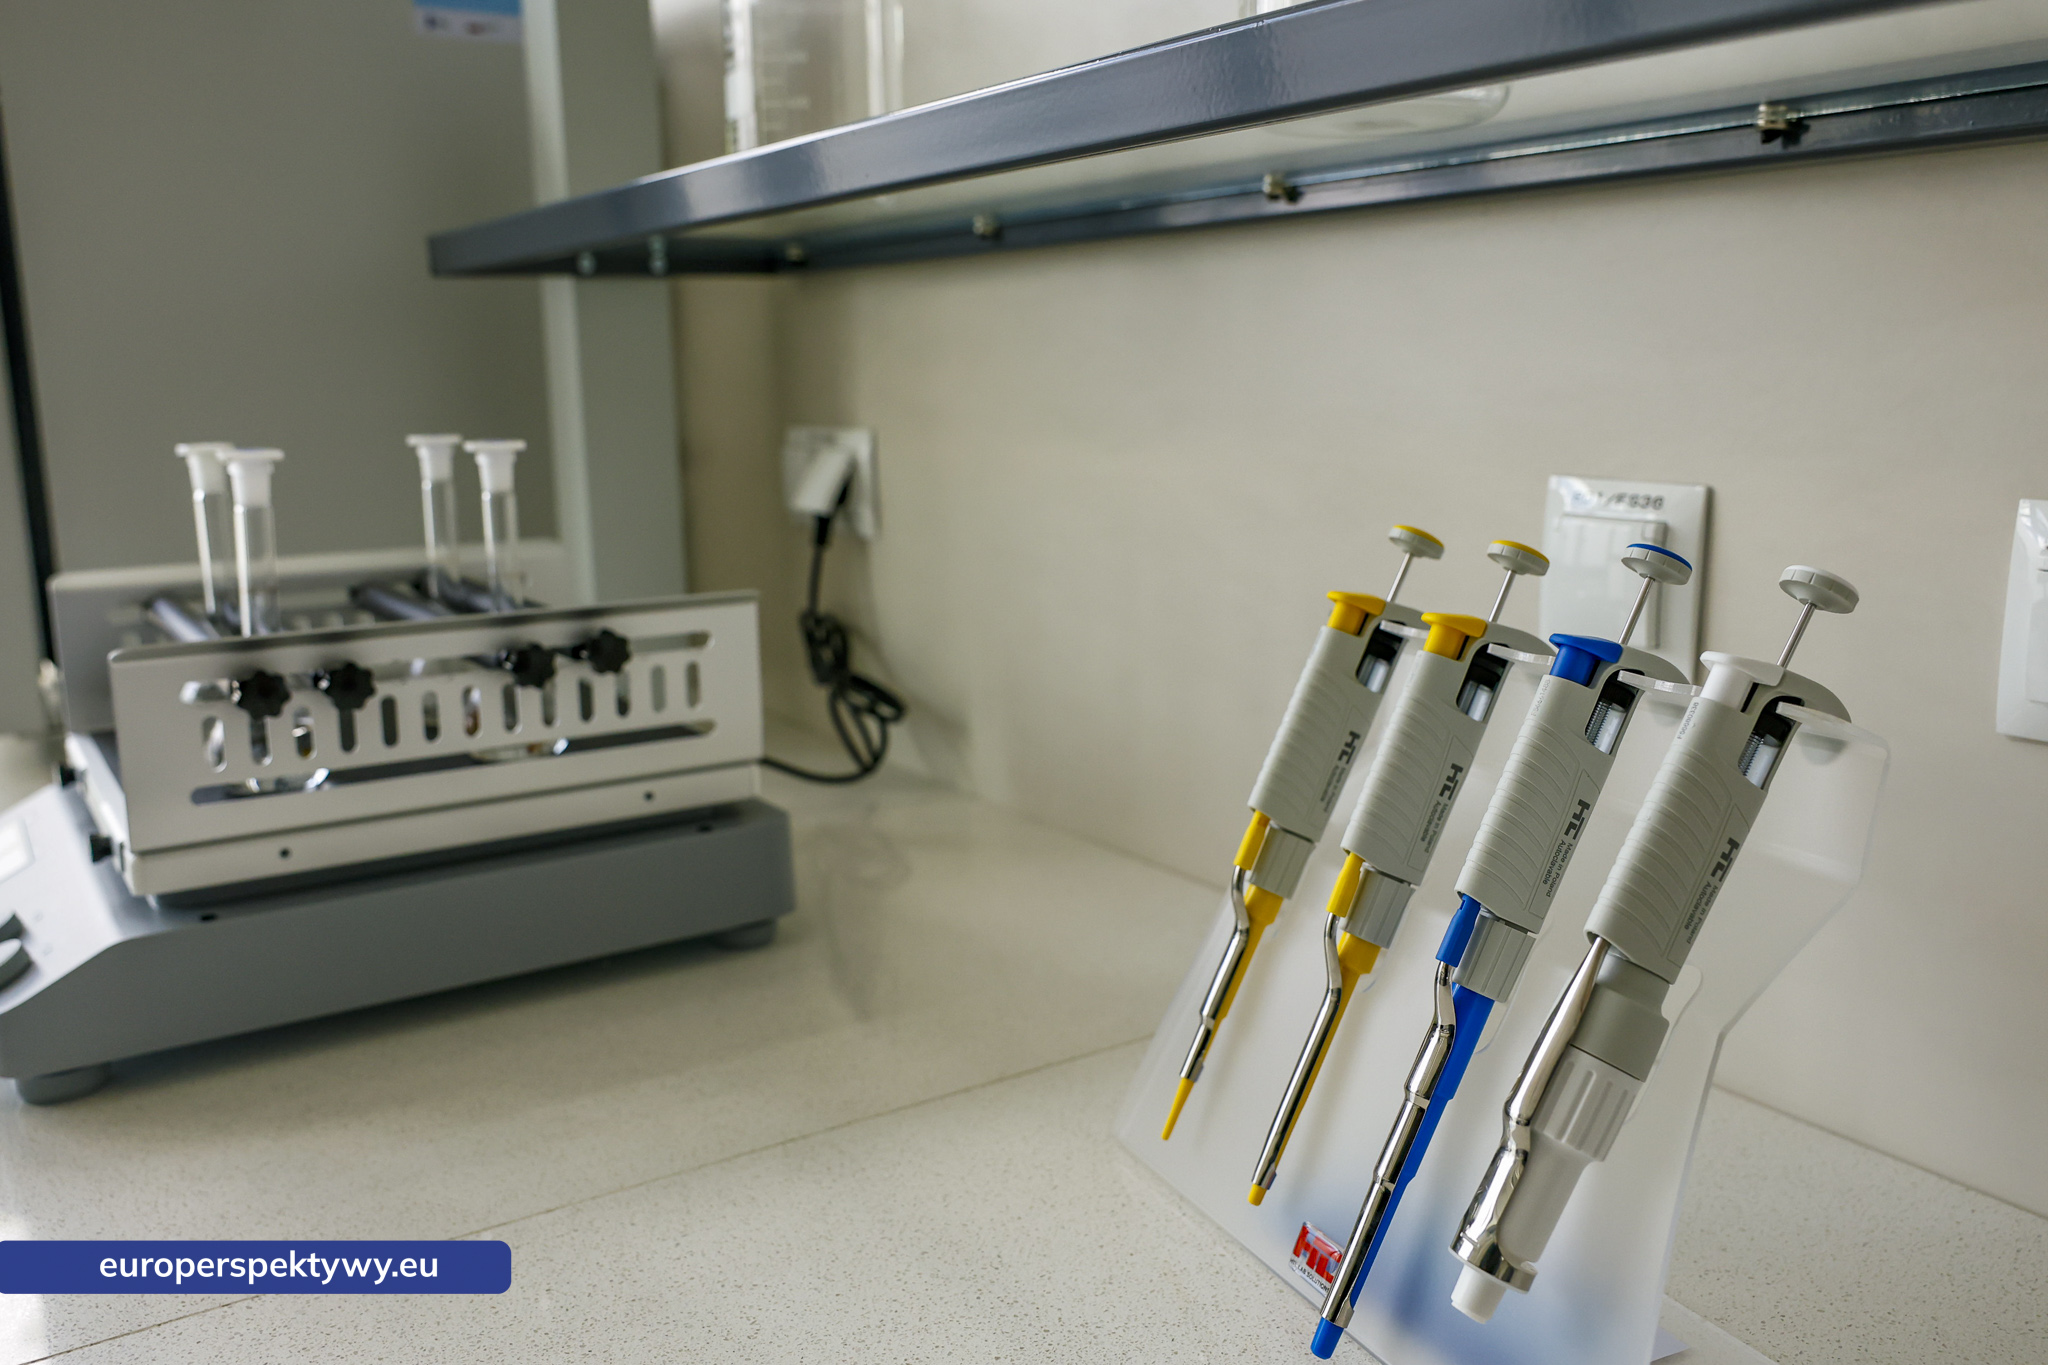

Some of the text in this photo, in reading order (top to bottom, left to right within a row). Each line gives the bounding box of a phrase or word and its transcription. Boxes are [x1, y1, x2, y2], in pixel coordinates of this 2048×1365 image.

[1420, 800, 1441, 842] Autoclavable
[1437, 803, 1448, 821] Made
[1424, 830, 1437, 853] Poland
[1560, 842, 1573, 863] Made
[1543, 840, 1566, 885] Autoclavable
[1546, 872, 1560, 898] Poland
[1684, 881, 1712, 930] Autoclavable
[1686, 885, 1718, 944] Made in Poland
